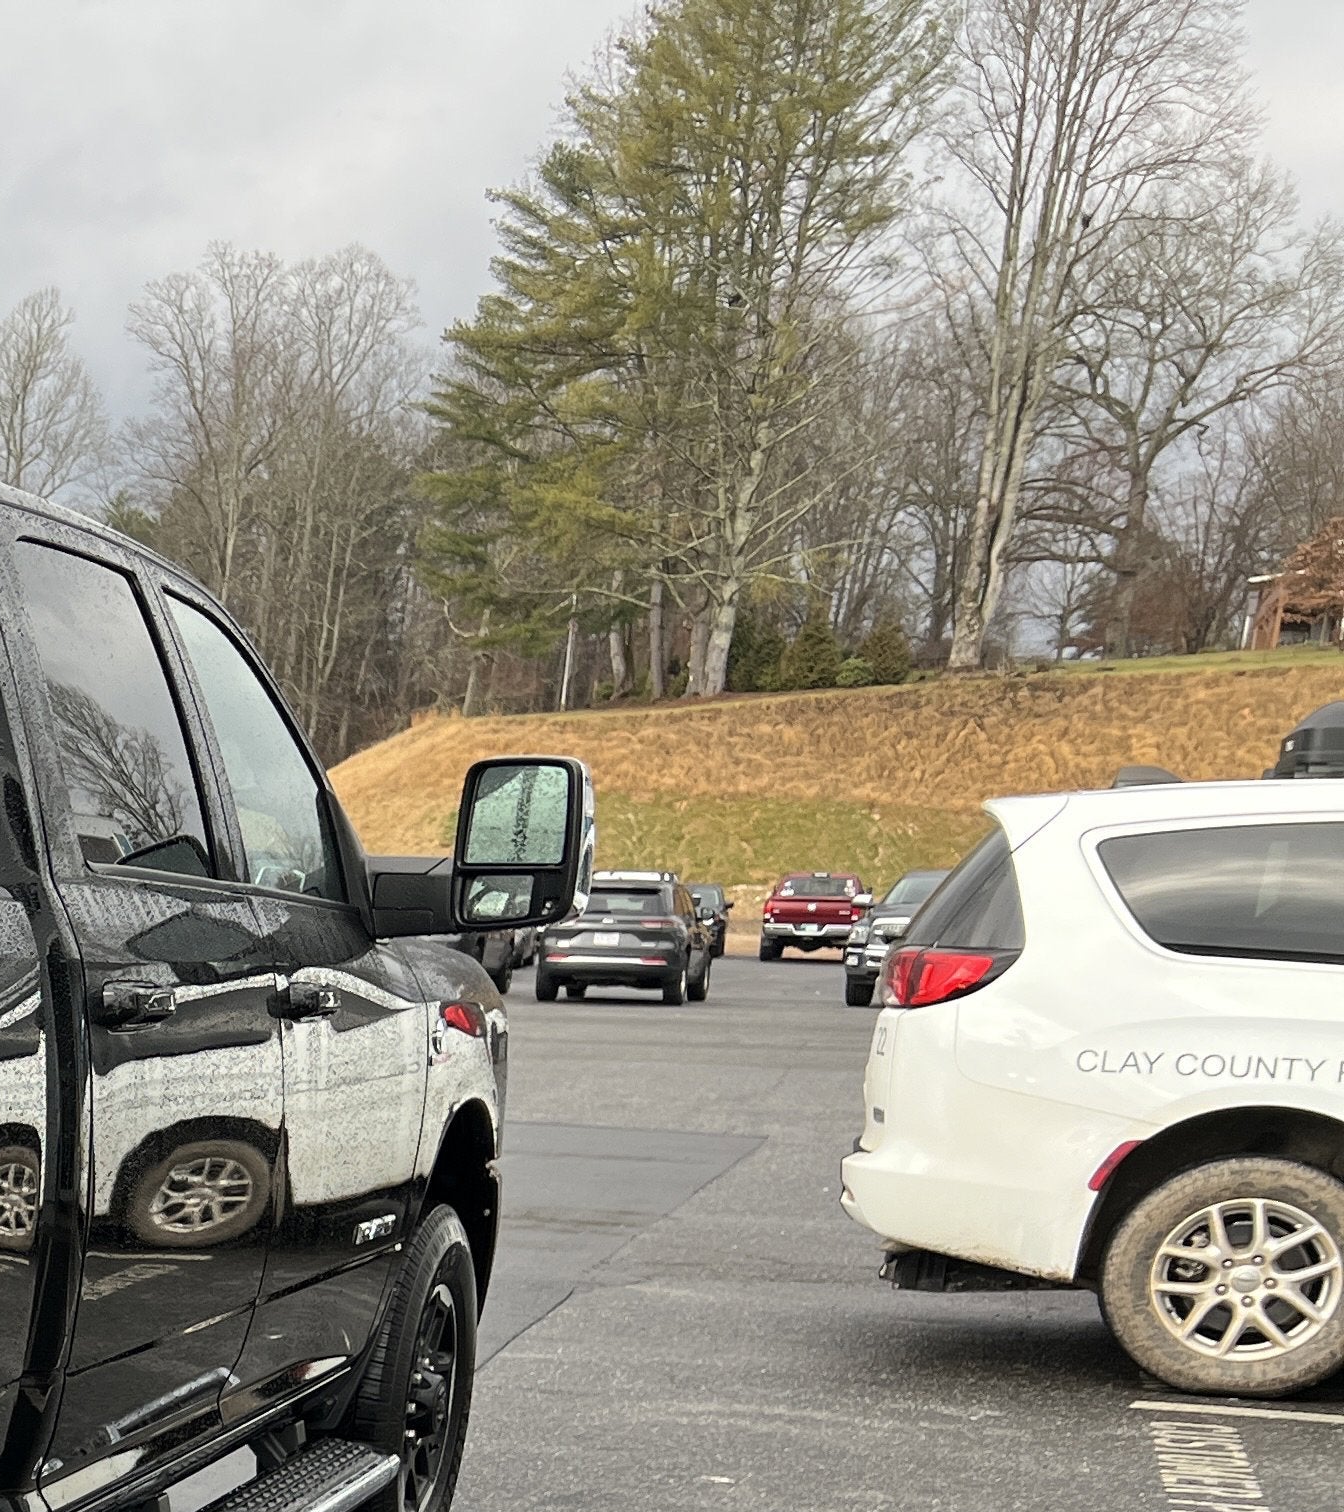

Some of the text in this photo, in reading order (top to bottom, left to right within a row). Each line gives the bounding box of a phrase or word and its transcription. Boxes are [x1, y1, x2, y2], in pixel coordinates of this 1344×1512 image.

[1076, 1049, 1165, 1075] CLAY
[1175, 1053, 1327, 1083] COUNTY
[1149, 1421, 1263, 1499] CUSTOMER
